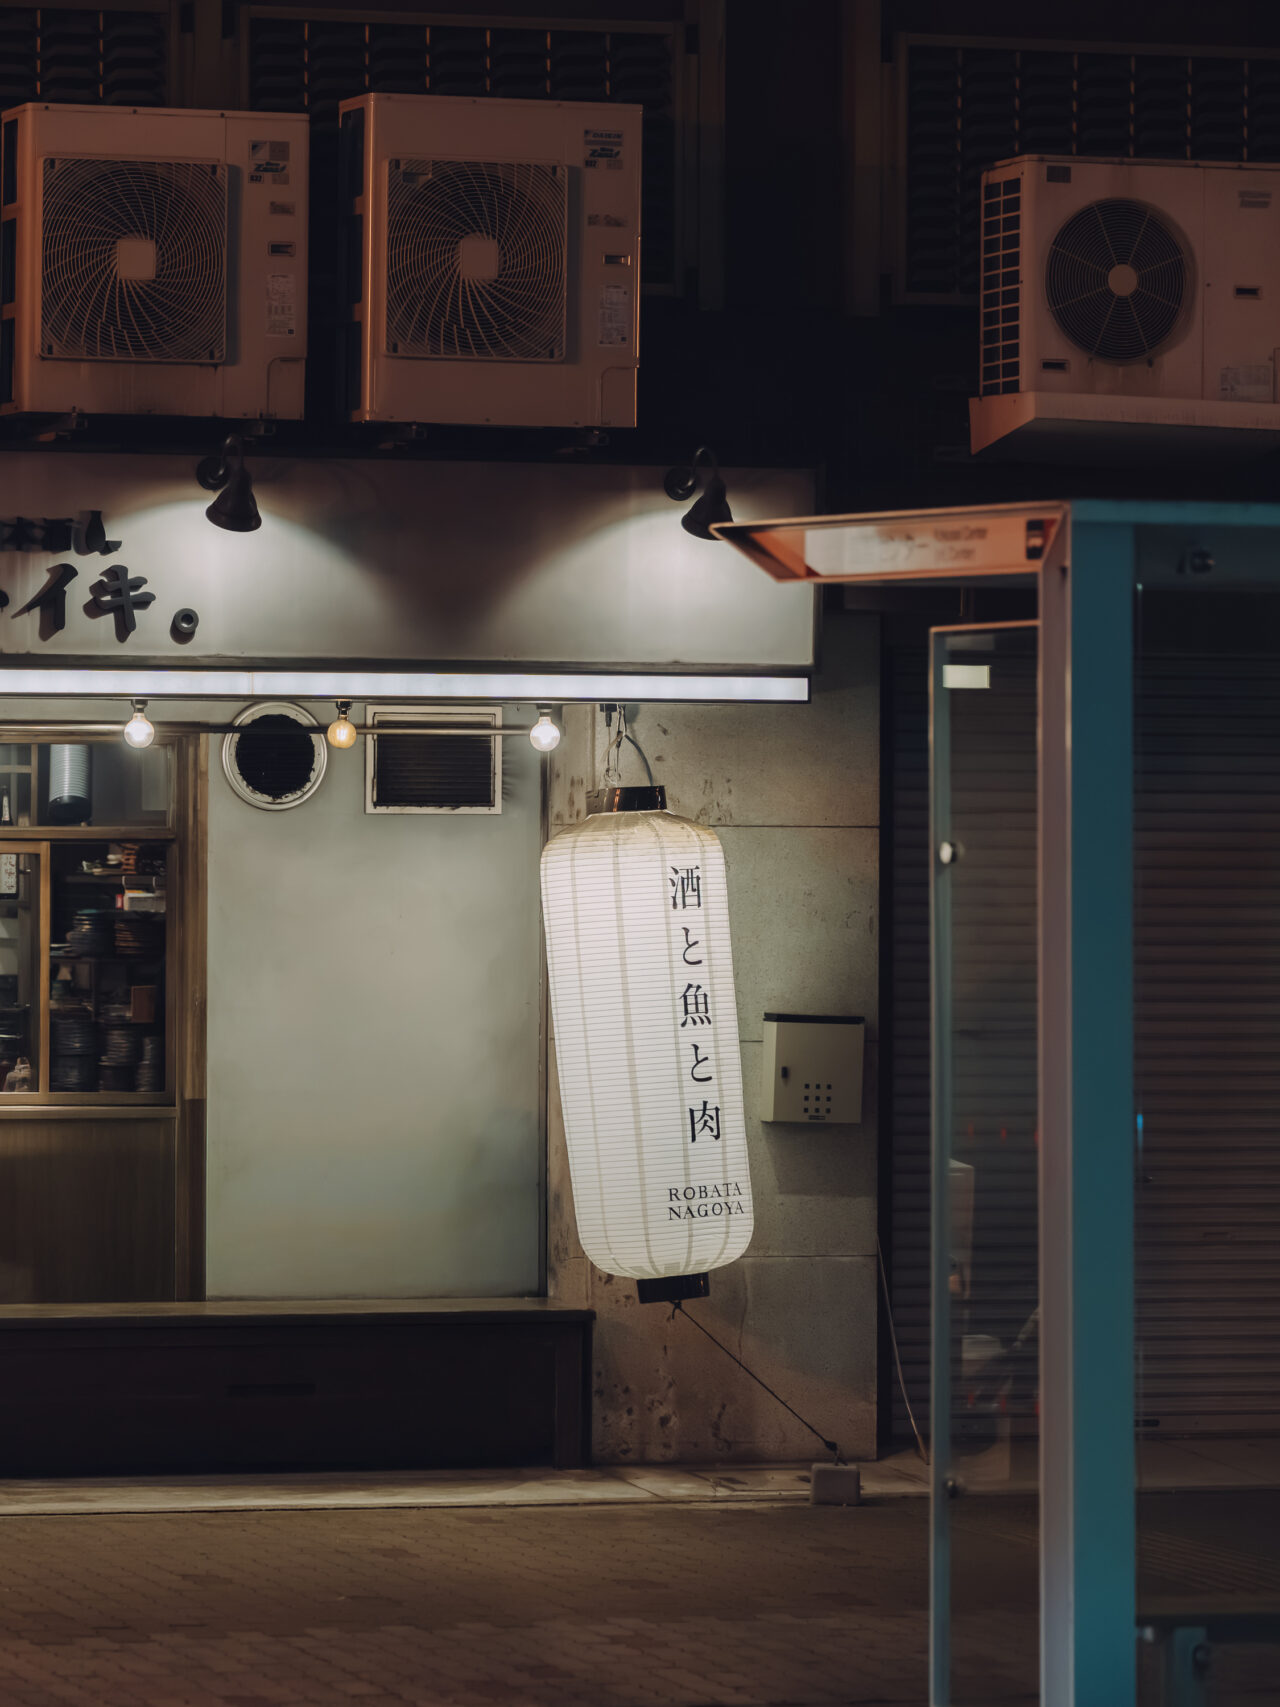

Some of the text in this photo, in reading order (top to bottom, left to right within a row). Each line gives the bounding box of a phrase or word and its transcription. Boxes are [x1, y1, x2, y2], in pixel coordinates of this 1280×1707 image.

[669, 865, 721, 1143] 酒と魚と肉
[669, 1182, 742, 1202] ROBATA
[668, 1201, 744, 1221] NAGOYA
